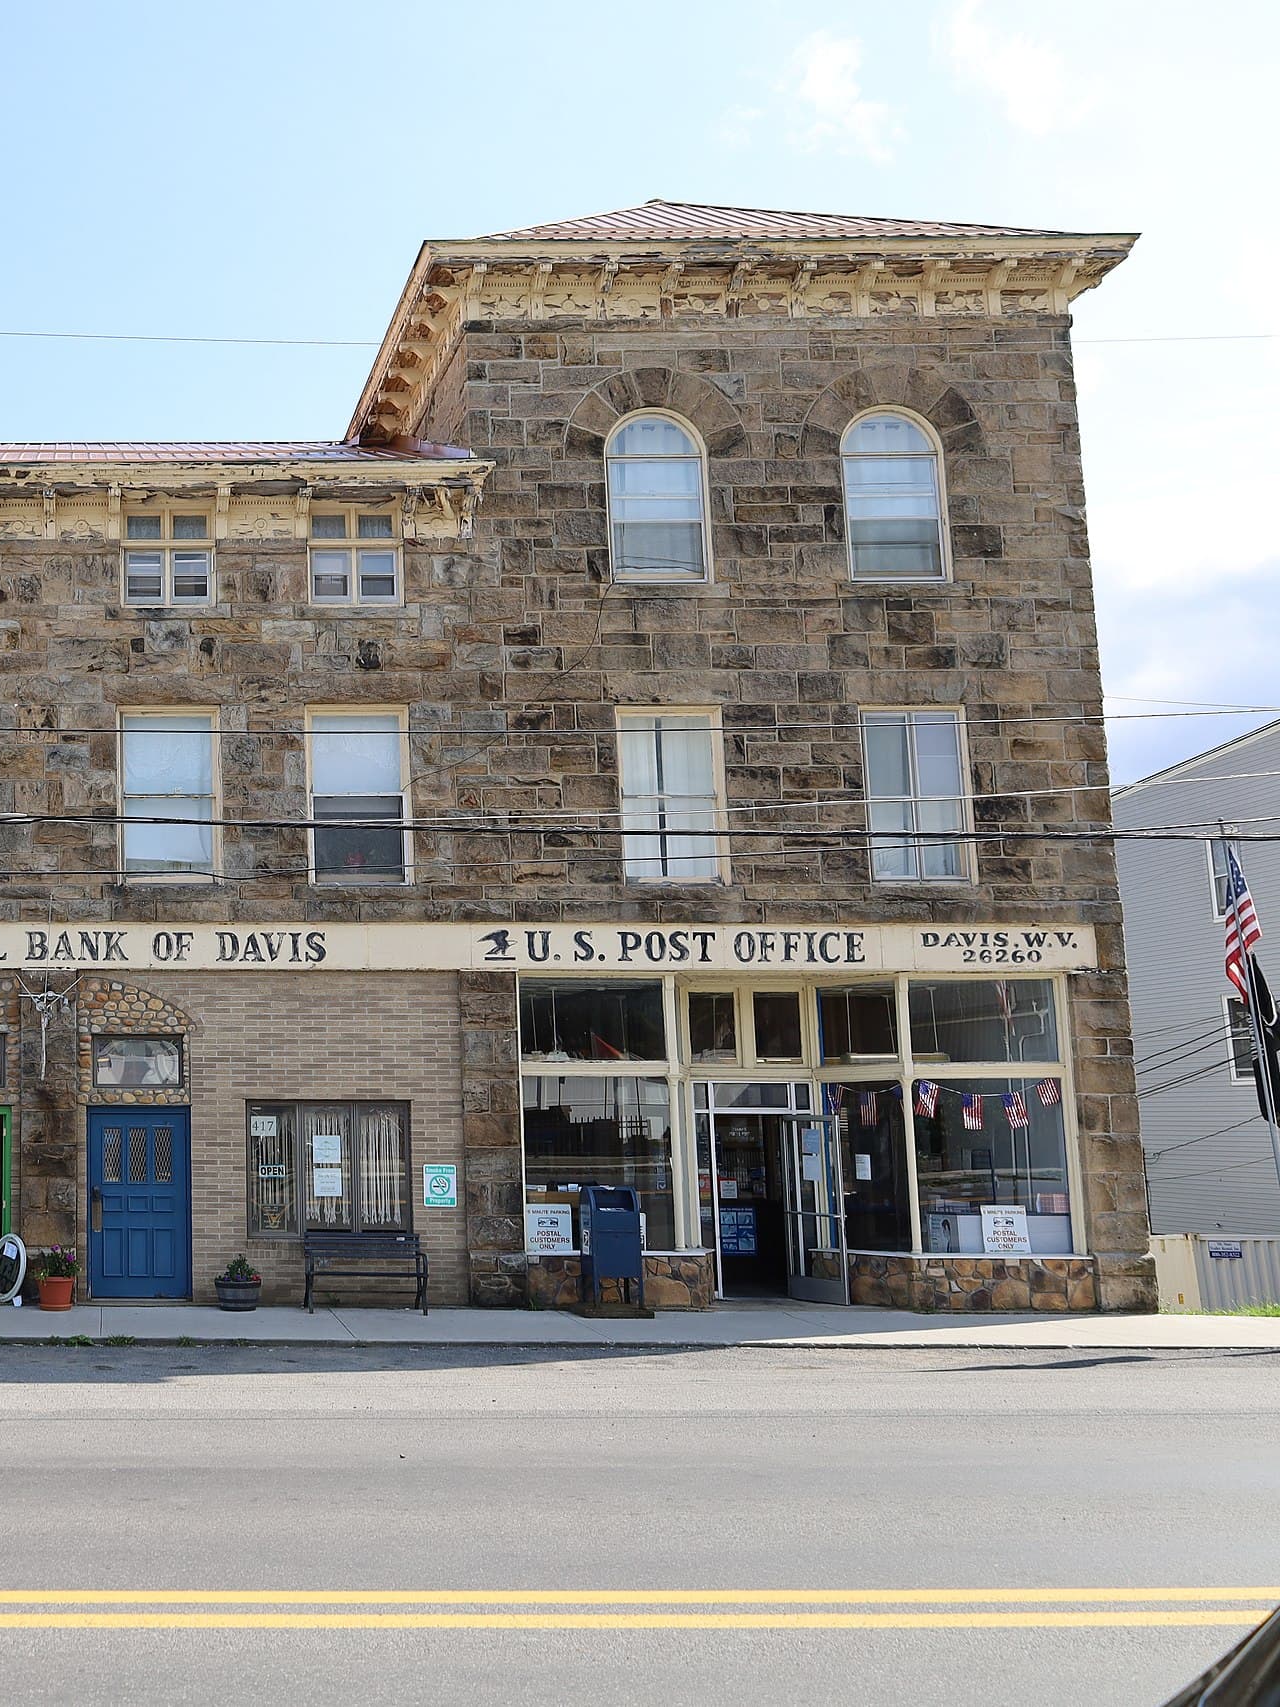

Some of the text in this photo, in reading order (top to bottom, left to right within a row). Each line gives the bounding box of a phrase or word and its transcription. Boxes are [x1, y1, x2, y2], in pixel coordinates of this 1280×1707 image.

[24, 930, 129, 961] BANK
[152, 931, 194, 961] OF
[216, 931, 327, 962] DAVIS
[617, 931, 716, 962] POST
[734, 931, 866, 963] OFFICE
[962, 949, 1043, 963] 26260
[252, 1120, 274, 1132] 417
[260, 1166, 285, 1176] OPEN
